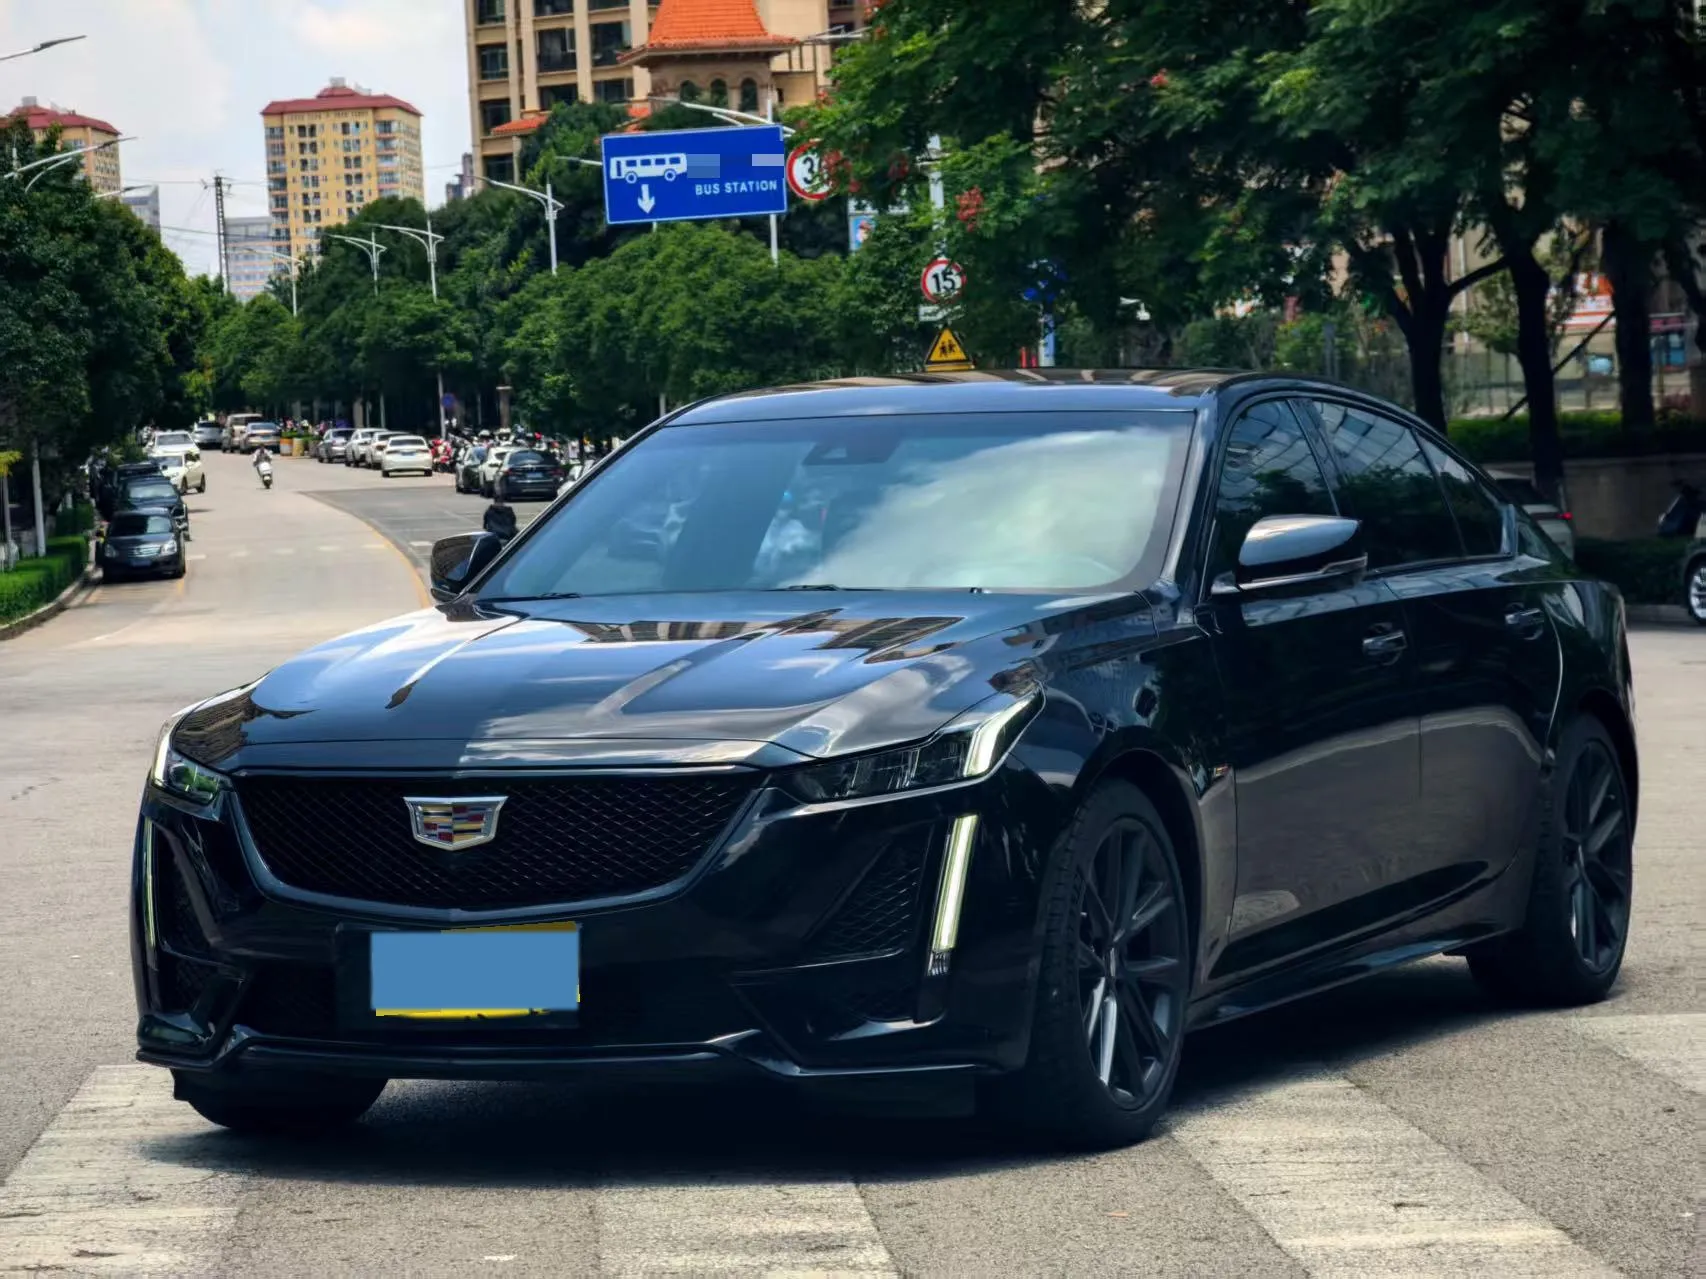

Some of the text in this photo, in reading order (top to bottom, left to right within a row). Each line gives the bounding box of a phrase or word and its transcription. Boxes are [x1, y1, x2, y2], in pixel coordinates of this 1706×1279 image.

[802, 157, 822, 184] 3
[695, 180, 778, 196] BUS STATION
[931, 270, 956, 292] 15
